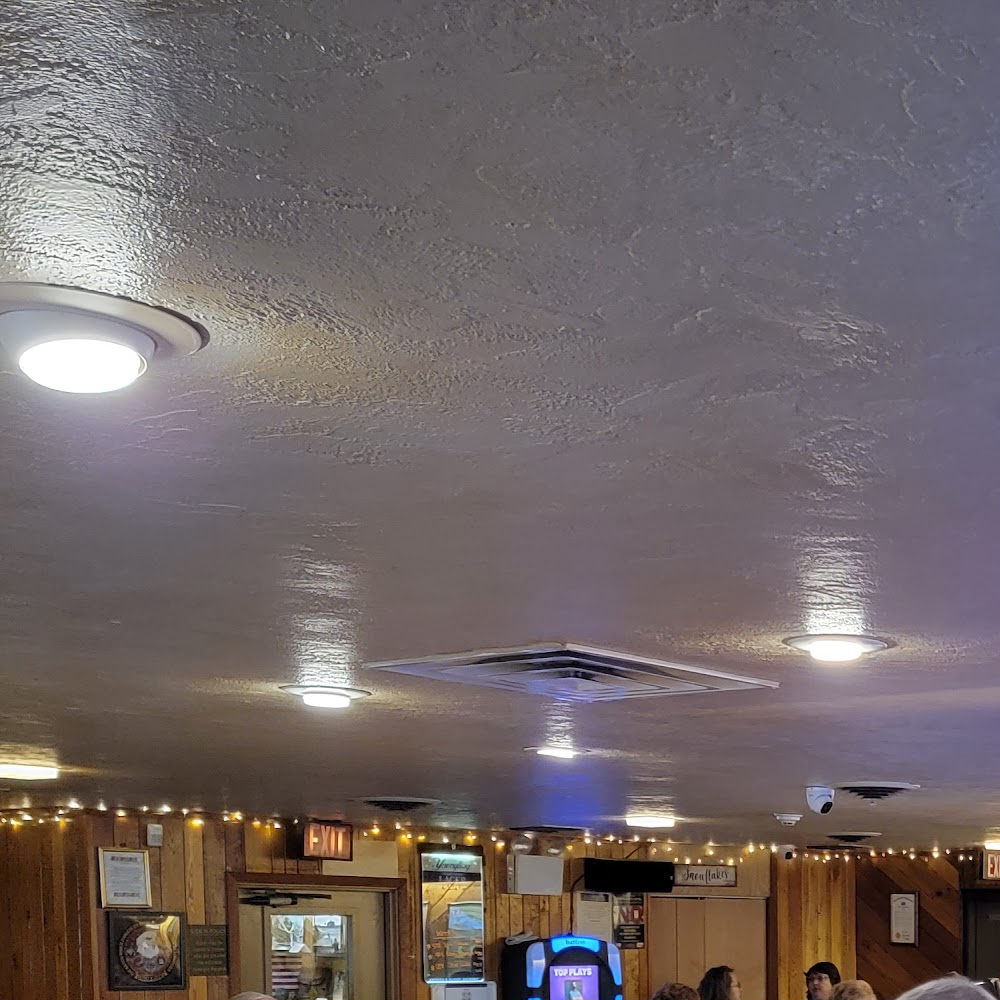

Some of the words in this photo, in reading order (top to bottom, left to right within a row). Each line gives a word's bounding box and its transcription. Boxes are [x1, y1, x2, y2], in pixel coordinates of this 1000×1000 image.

[309, 824, 347, 856] EXIT
[553, 968, 569, 977] TOP
[569, 967, 592, 977] PLAYS
